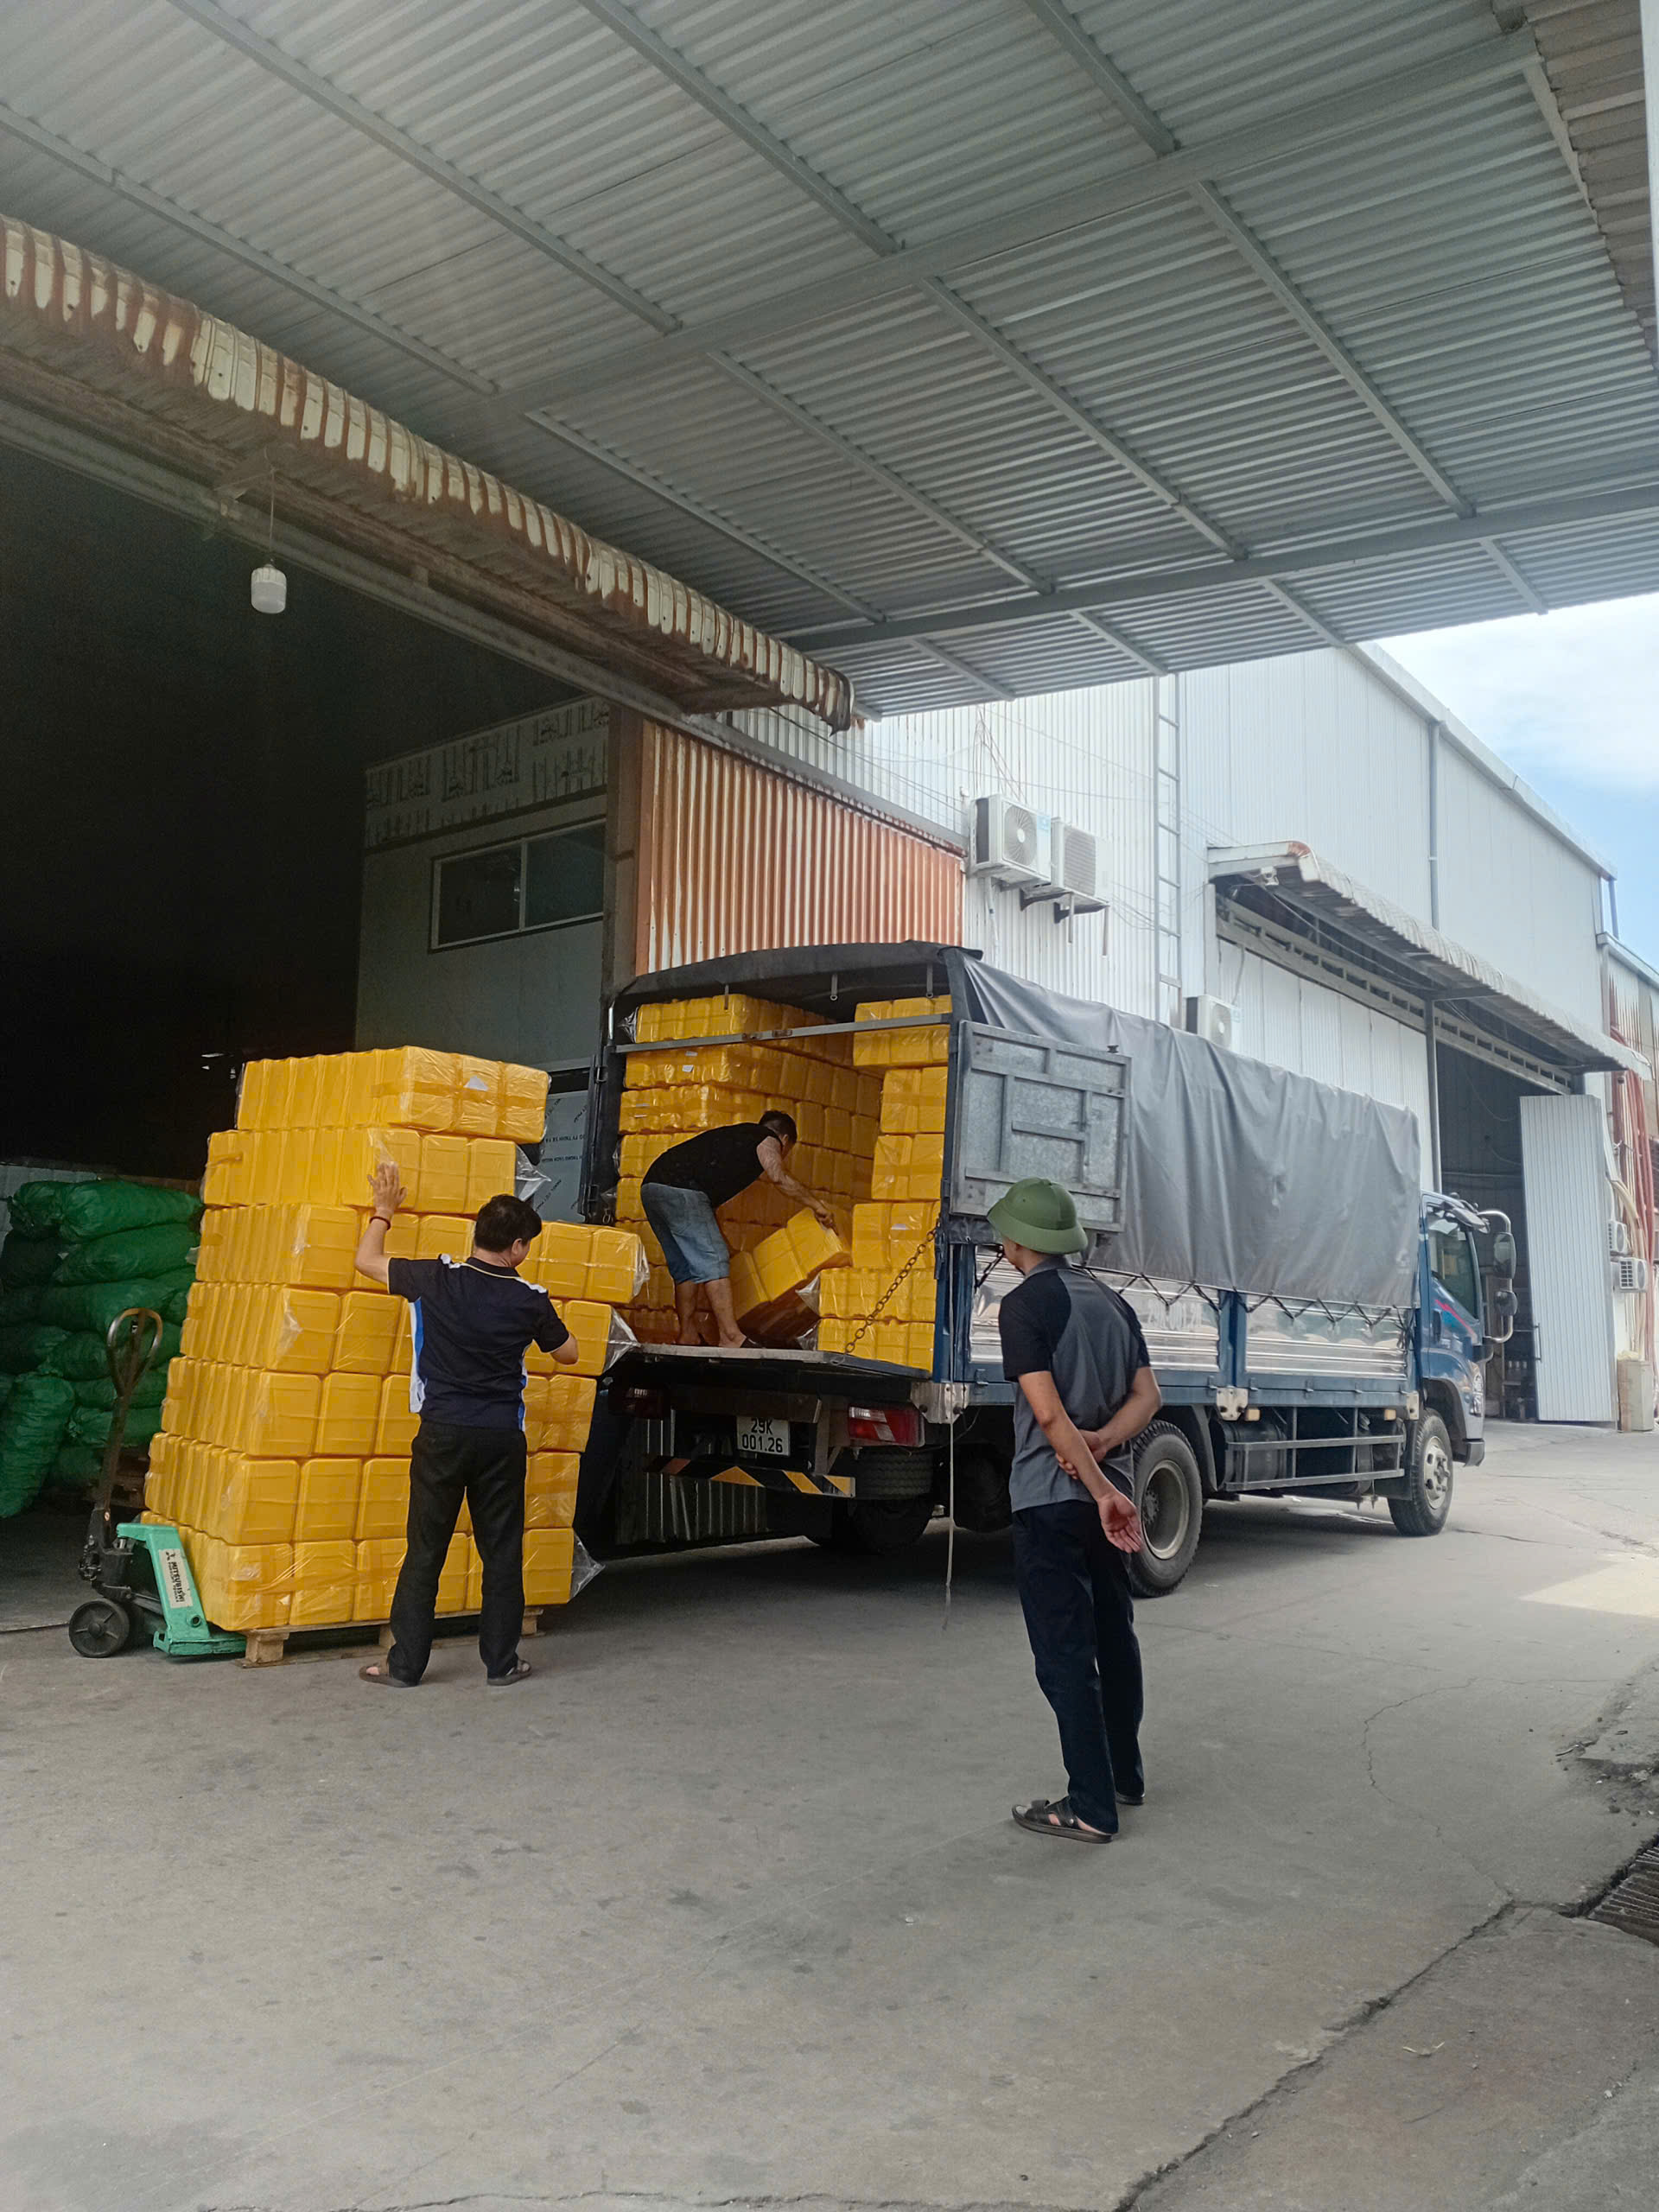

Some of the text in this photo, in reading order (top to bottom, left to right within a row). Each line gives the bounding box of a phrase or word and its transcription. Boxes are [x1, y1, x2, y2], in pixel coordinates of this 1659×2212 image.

[751, 1418, 773, 1435] 29K
[741, 1433, 783, 1453] 001.26
[171, 1561, 186, 1602] MITSUBISHI
